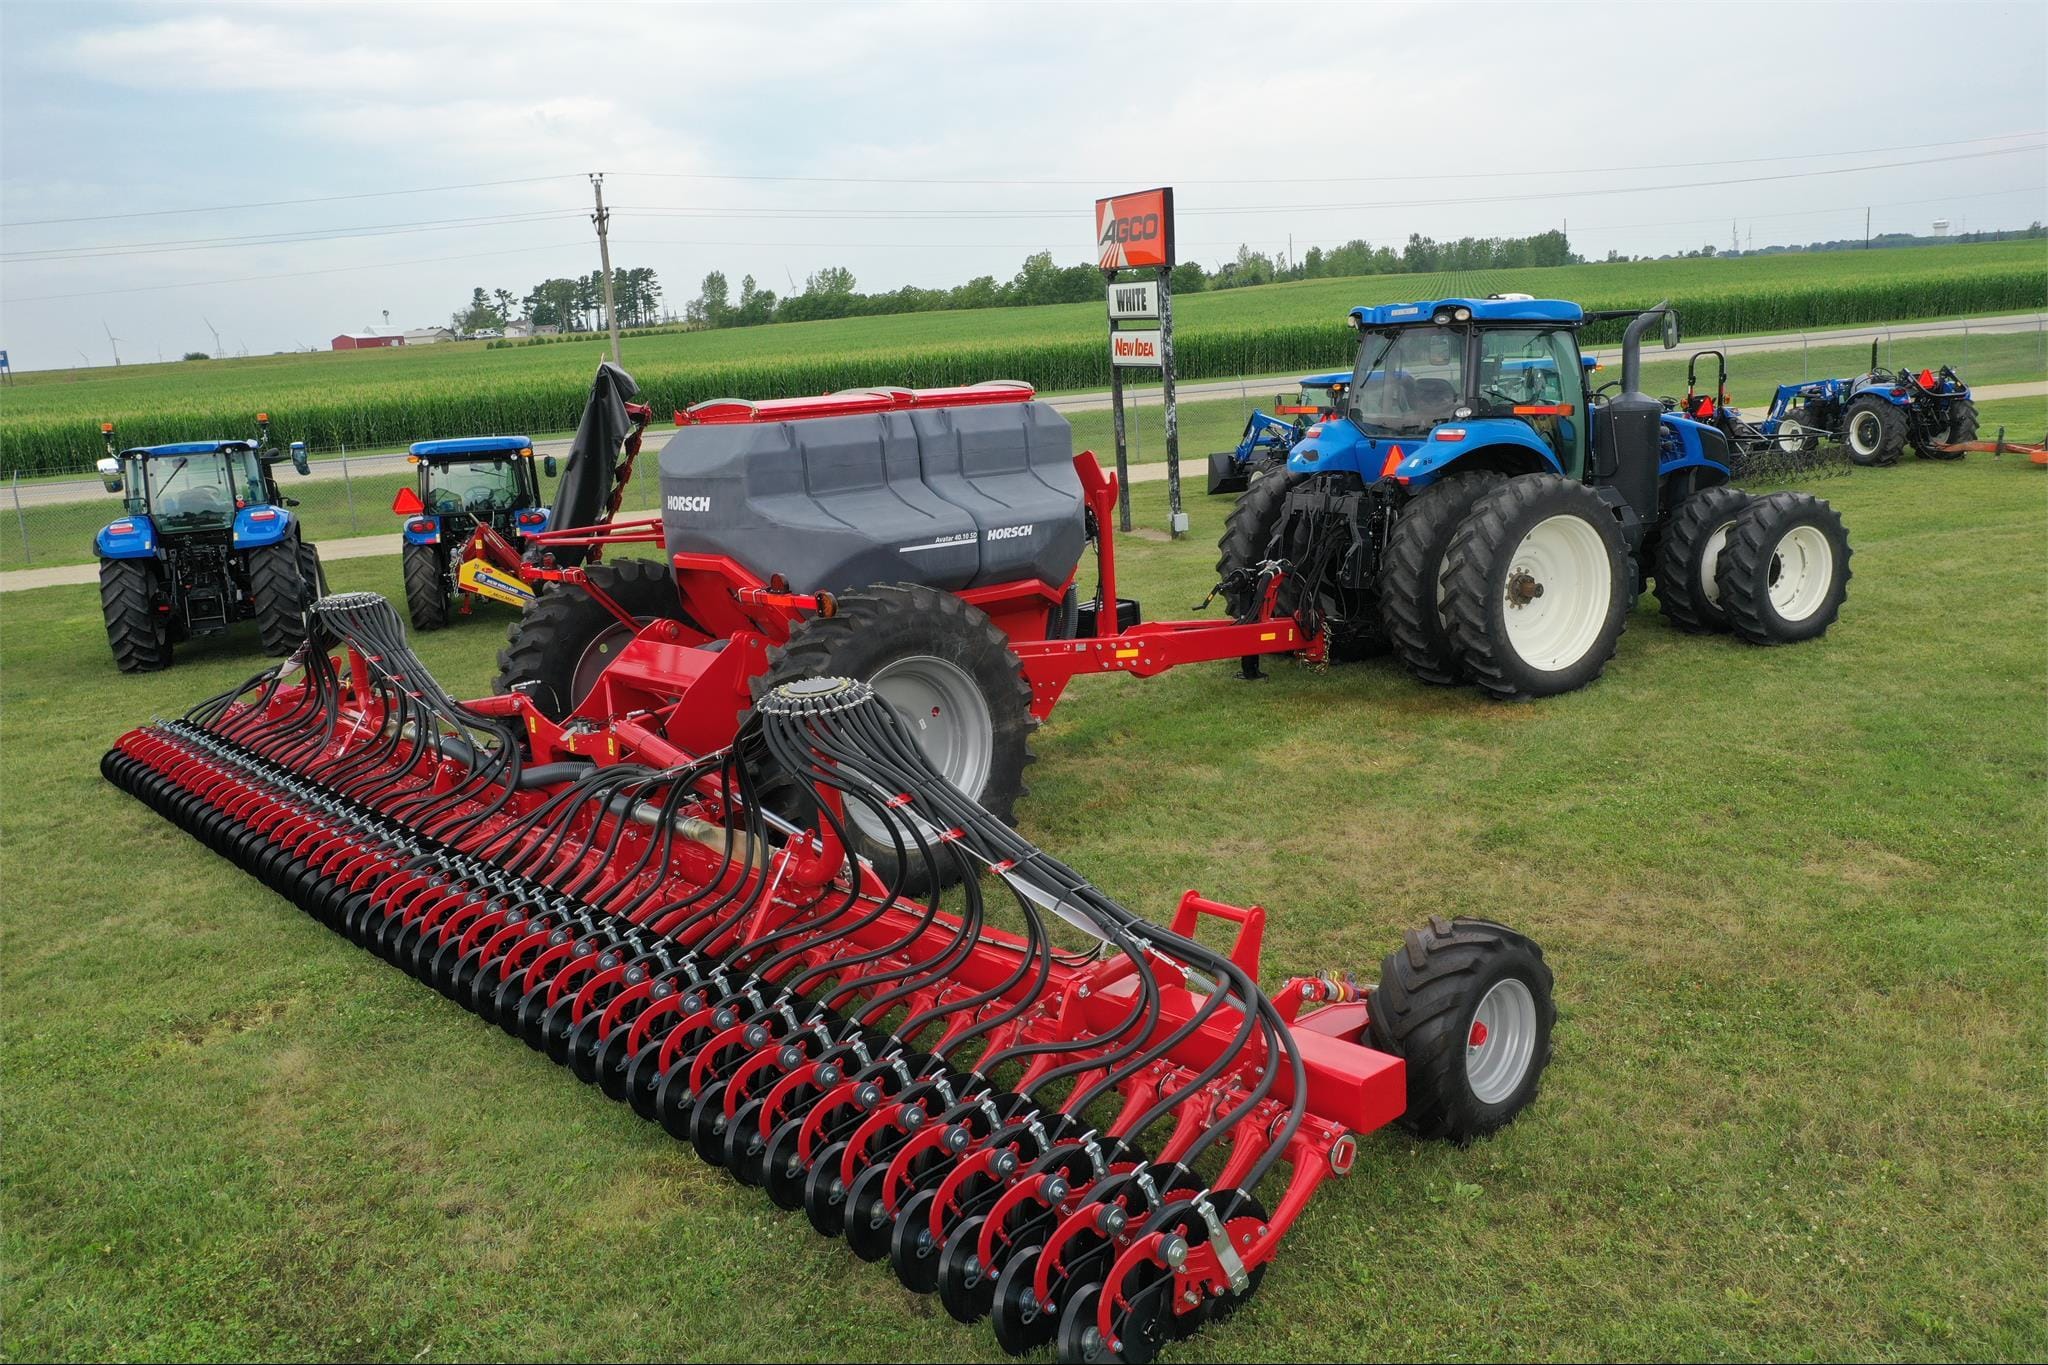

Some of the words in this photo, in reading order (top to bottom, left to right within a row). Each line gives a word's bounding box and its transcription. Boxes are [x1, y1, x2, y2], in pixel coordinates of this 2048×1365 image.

[1099, 213, 1158, 246] AGCO
[1116, 288, 1147, 312] WHITE
[667, 495, 711, 512] HORSCH
[987, 525, 1033, 541] HORSCH
